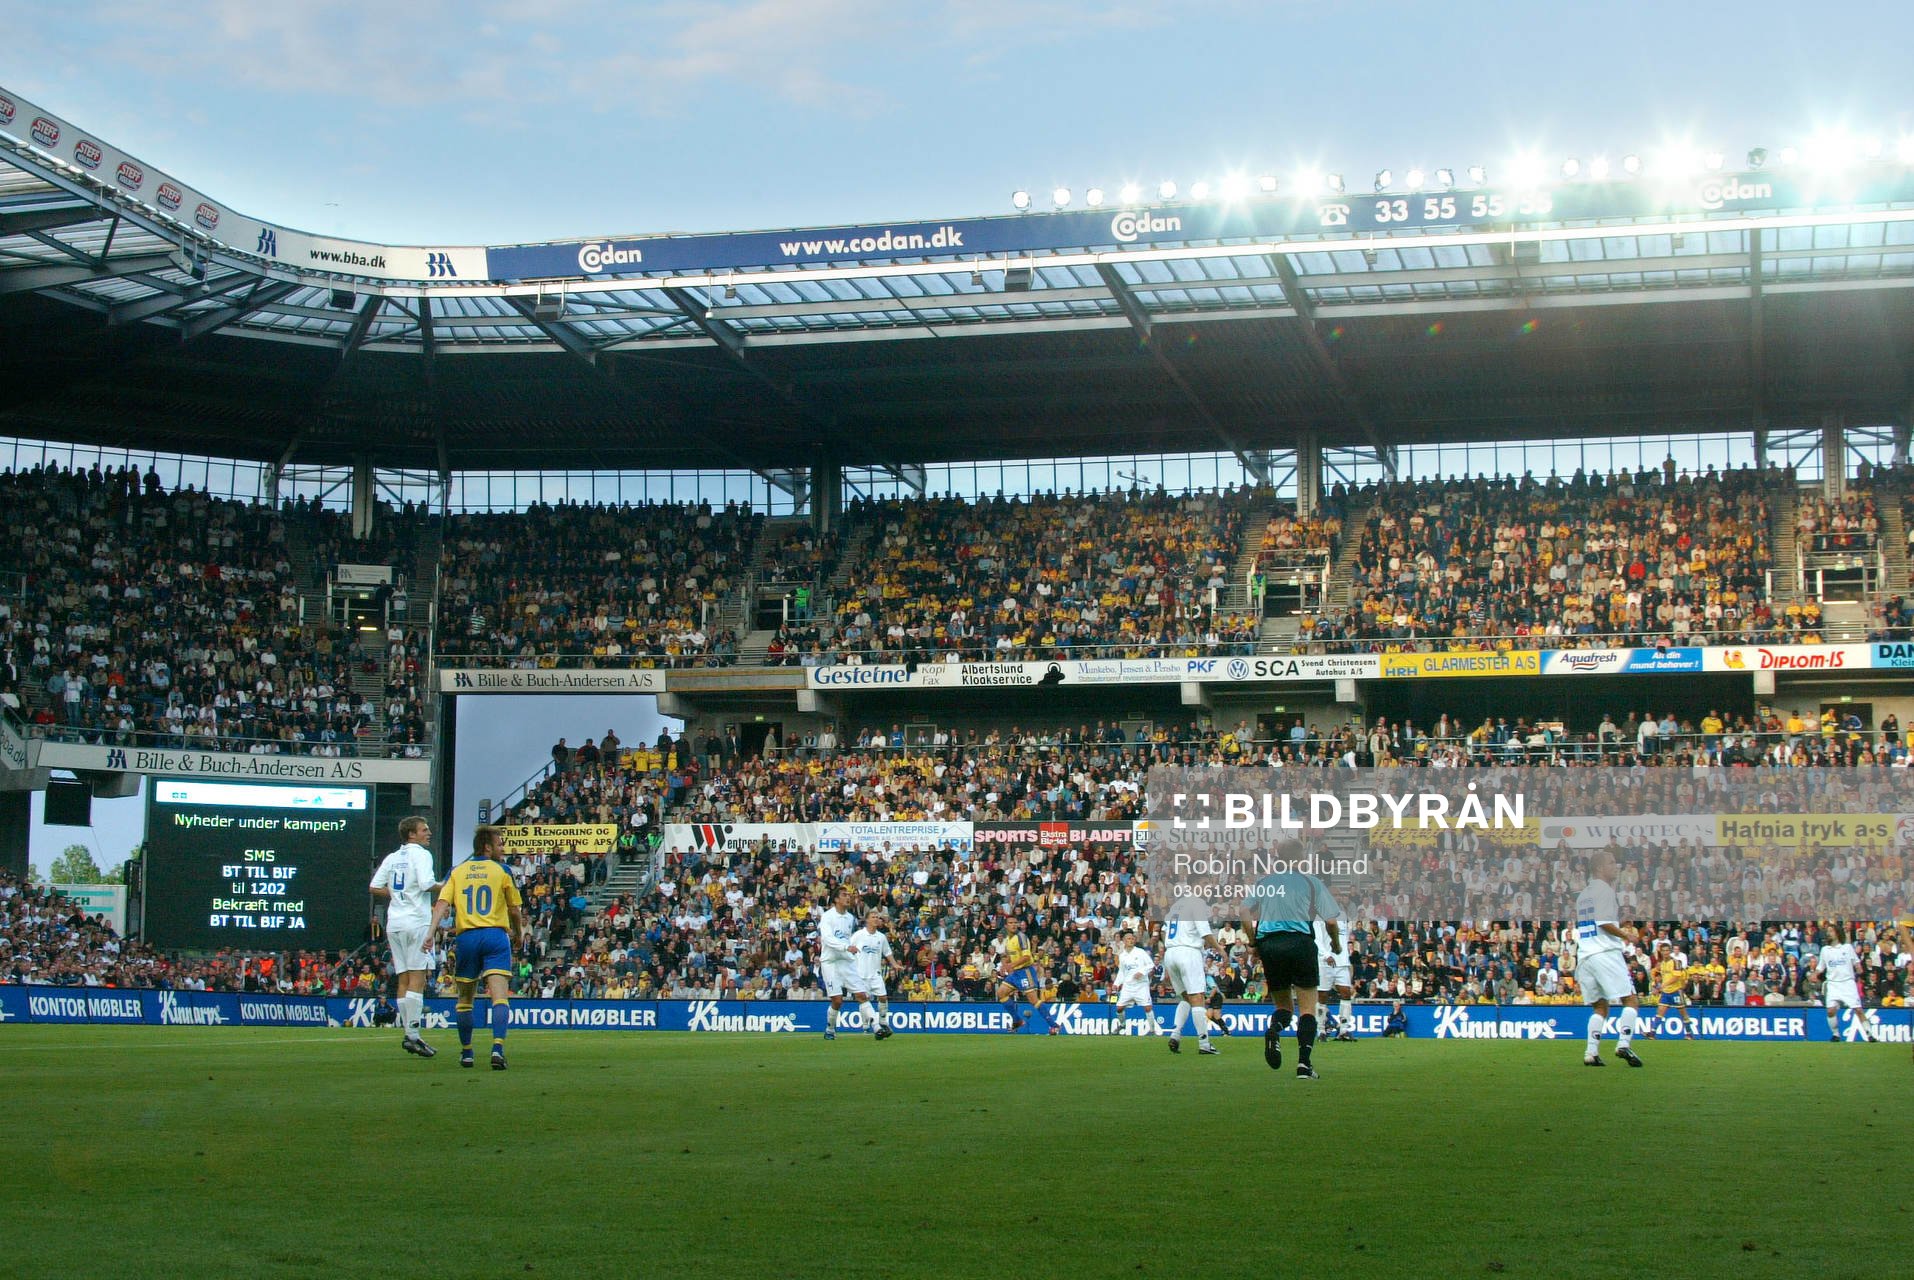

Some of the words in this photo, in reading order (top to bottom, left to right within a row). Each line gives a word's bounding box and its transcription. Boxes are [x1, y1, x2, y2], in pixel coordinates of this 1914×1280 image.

[36, 120, 59, 137] STEFF
[79, 142, 101, 160] STEFF
[121, 164, 142, 183] STEFF
[159, 184, 181, 202] STEFF
[198, 205, 219, 222] STEFF
[1375, 199, 1409, 223] 33
[1424, 197, 1456, 220] 55
[1471, 195, 1504, 217] 55
[1111, 212, 1181, 241] Codan
[779, 226, 964, 257] www.codan.dk
[309, 249, 386, 269] www.bba.dk
[578, 243, 642, 273] Codan
[1301, 659, 1324, 668] Svend
[1327, 658, 1376, 667] Christensens
[1423, 656, 1510, 671] GLARMESTER
[1514, 655, 1536, 669] A/S
[1560, 652, 1617, 663] Aquafresh
[961, 663, 1024, 676] Albertslund
[1187, 660, 1217, 673] PKF
[1255, 660, 1299, 678] SCA
[1350, 667, 1363, 676] A/S
[1385, 666, 1417, 676] HRH
[478, 673, 508, 687] Bille
[511, 674, 523, 687] &
[527, 673, 625, 687] Buch-Andersen
[628, 673, 653, 687] A/S
[814, 666, 912, 685] Gestetner
[961, 674, 1032, 685] Kloakservice
[135, 751, 175, 770] Bille
[178, 753, 193, 771] &
[199, 754, 325, 778] Buch-Andersen
[330, 761, 363, 779] A/S
[174, 813, 234, 829] Nyheder
[238, 816, 279, 829] under
[283, 817, 347, 833] kampen?
[850, 825, 941, 834] TOTALENTREPRISE
[1586, 823, 1689, 838] WICOTEC
[1722, 819, 1795, 838] Hafnia
[1801, 819, 1847, 841] tryk
[819, 838, 851, 849] HRH
[938, 838, 972, 848] HRH
[974, 829, 1038, 843] SPORTS
[1069, 829, 1132, 842] BLADET
[1135, 830, 1162, 841] EDC
[1169, 826, 1271, 844] Strandfelt
[244, 849, 275, 862] SMS
[222, 865, 242, 878] BT
[245, 866, 269, 878] TIL
[272, 867, 297, 879] BIF
[232, 882, 245, 894] til
[250, 882, 286, 895] 1202
[212, 898, 269, 911] Bekræft
[273, 899, 304, 912] med
[462, 884, 492, 916] 10
[210, 914, 229, 927] BT
[232, 915, 257, 928] TIL
[260, 916, 285, 928] BIF
[287, 917, 305, 928] JA
[29, 996, 87, 1018] KONTOR
[88, 998, 143, 1018] MØBLER
[240, 1003, 285, 1020] KONTOR
[286, 1005, 327, 1022] MØBLER
[571, 1008, 656, 1026] MØBLER
[688, 1001, 811, 1032] Kinnarps
[1433, 1005, 1574, 1039] Kinnarps
[1702, 1016, 1805, 1036] MØBLER
